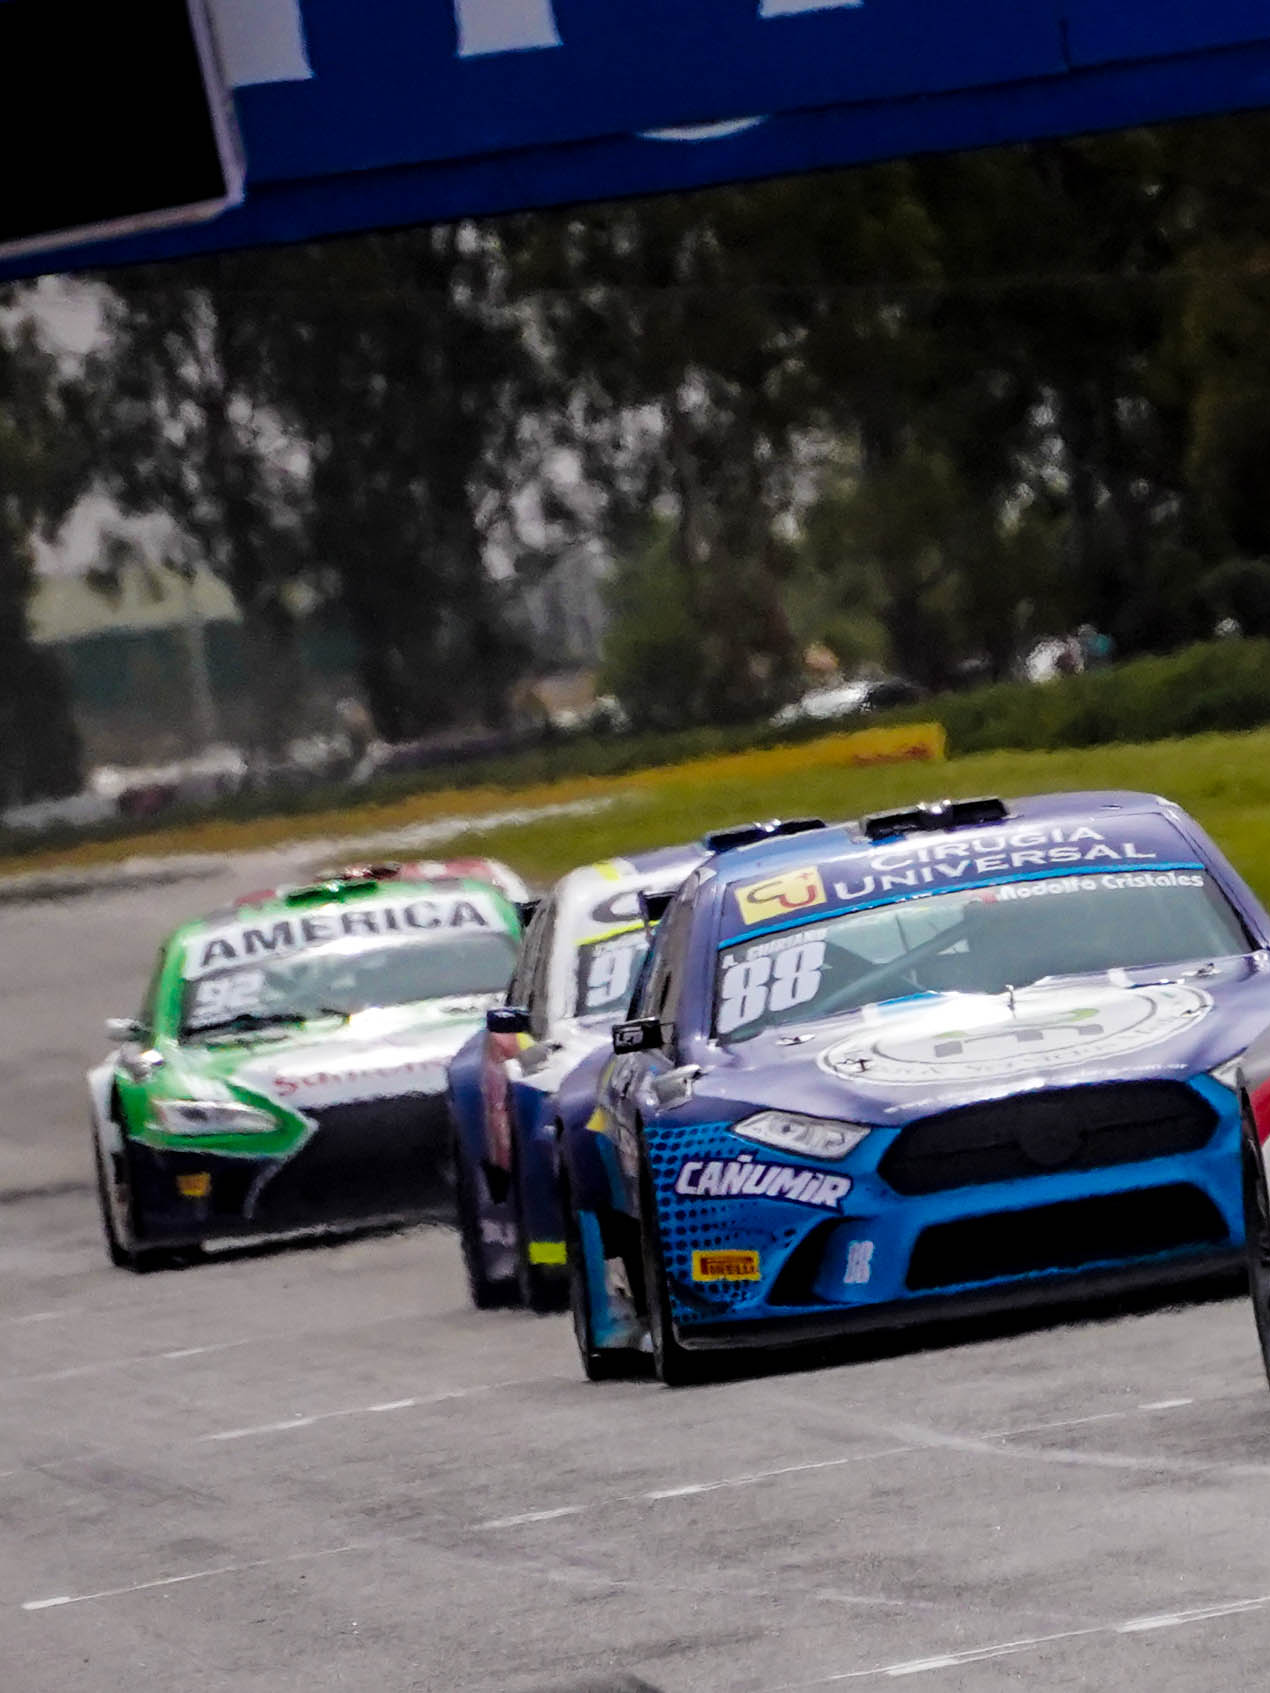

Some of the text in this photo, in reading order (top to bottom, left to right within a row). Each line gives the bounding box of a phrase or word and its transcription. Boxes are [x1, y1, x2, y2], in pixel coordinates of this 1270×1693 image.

[834, 842, 1157, 901] UNIVERSAL
[870, 827, 1105, 872] CIRUGIA
[997, 871, 1205, 900] Rodolfo Cristales
[202, 901, 488, 966] AMERICA
[717, 940, 827, 1034] 88
